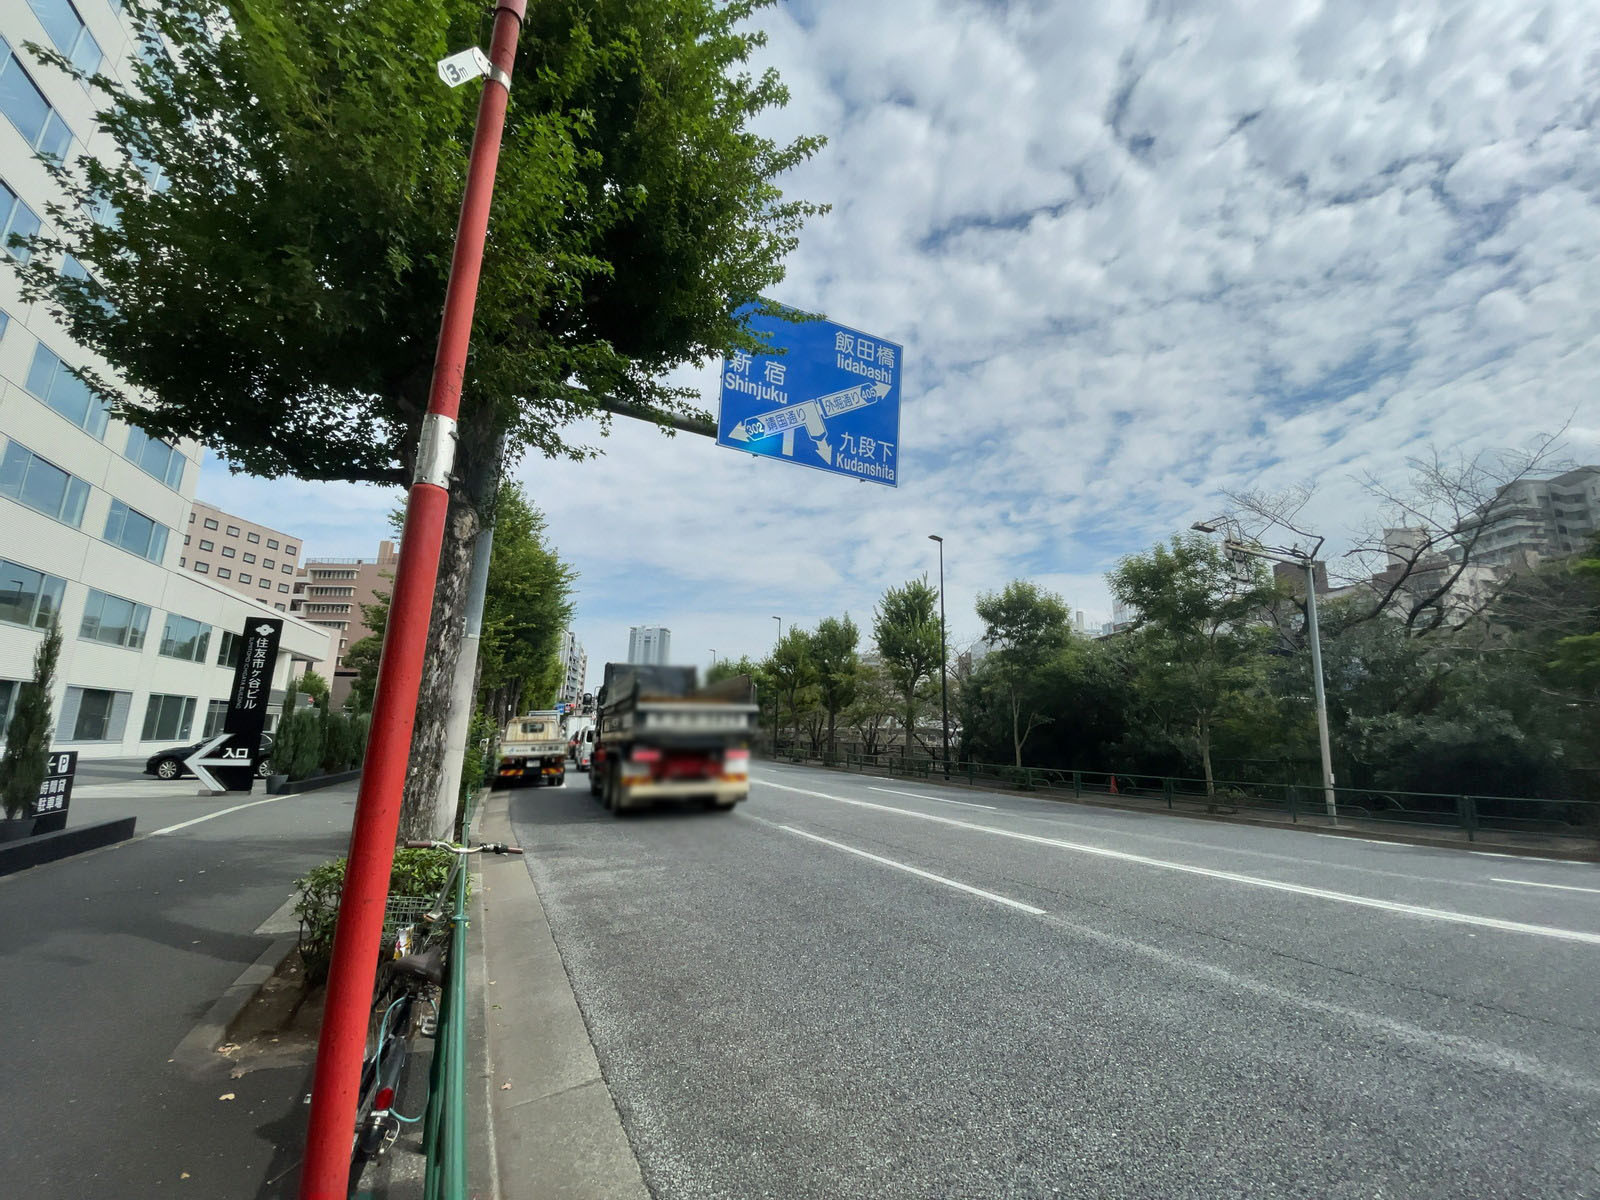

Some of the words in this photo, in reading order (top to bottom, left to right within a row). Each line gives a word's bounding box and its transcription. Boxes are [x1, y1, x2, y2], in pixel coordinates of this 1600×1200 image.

[835, 331, 895, 368] 飯田橋
[729, 350, 786, 386] 新宿
[837, 354, 892, 384] Iidabashi
[725, 372, 788, 404] Shinjuku
[825, 392, 860, 413] 外堀通り
[861, 388, 876, 400] 405
[746, 422, 764, 435] 302
[765, 408, 807, 431] 靖国通り
[839, 431, 894, 462] 九段下
[836, 452, 894, 481] Kudanshita
[222, 748, 248, 758] 入口
